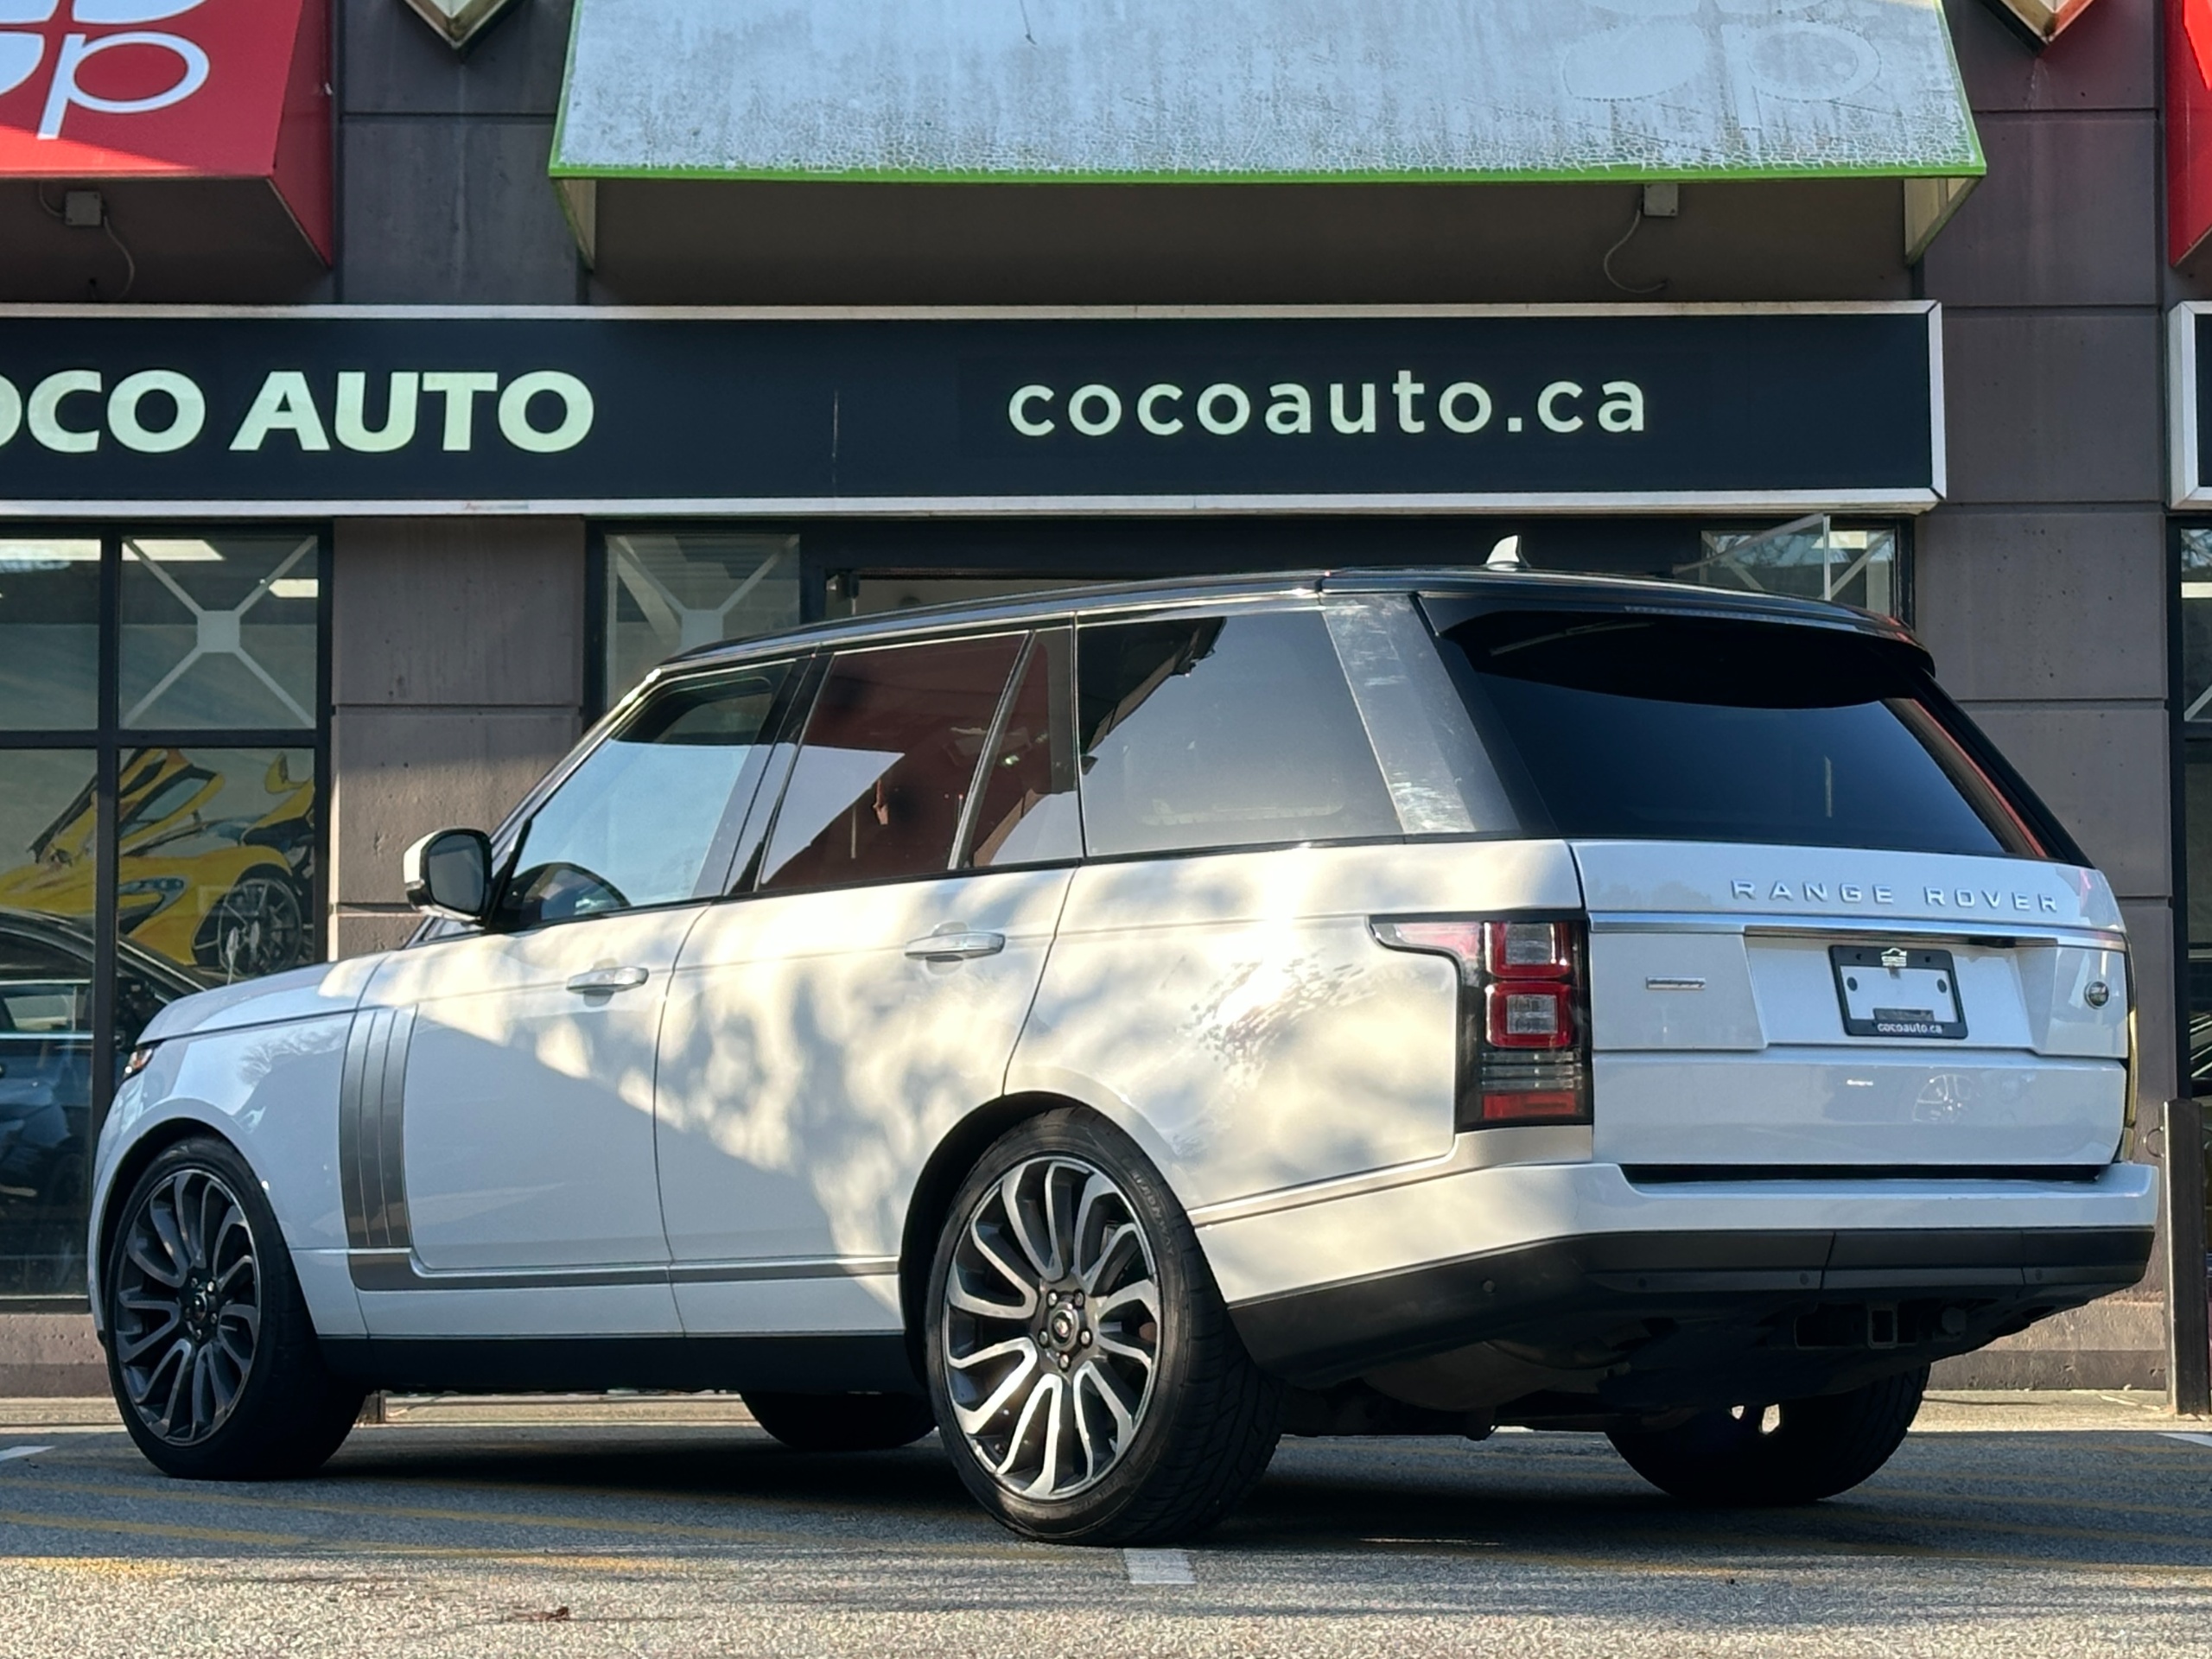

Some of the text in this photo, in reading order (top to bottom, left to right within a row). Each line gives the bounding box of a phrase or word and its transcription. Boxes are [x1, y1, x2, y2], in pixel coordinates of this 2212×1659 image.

[0, 370, 594, 453] CO AUTO
[1008, 370, 1645, 436] cocoauto.ca
[1731, 879, 2057, 912] RANGE ROVER
[1877, 1021, 1943, 1034] cocoauto.ca
